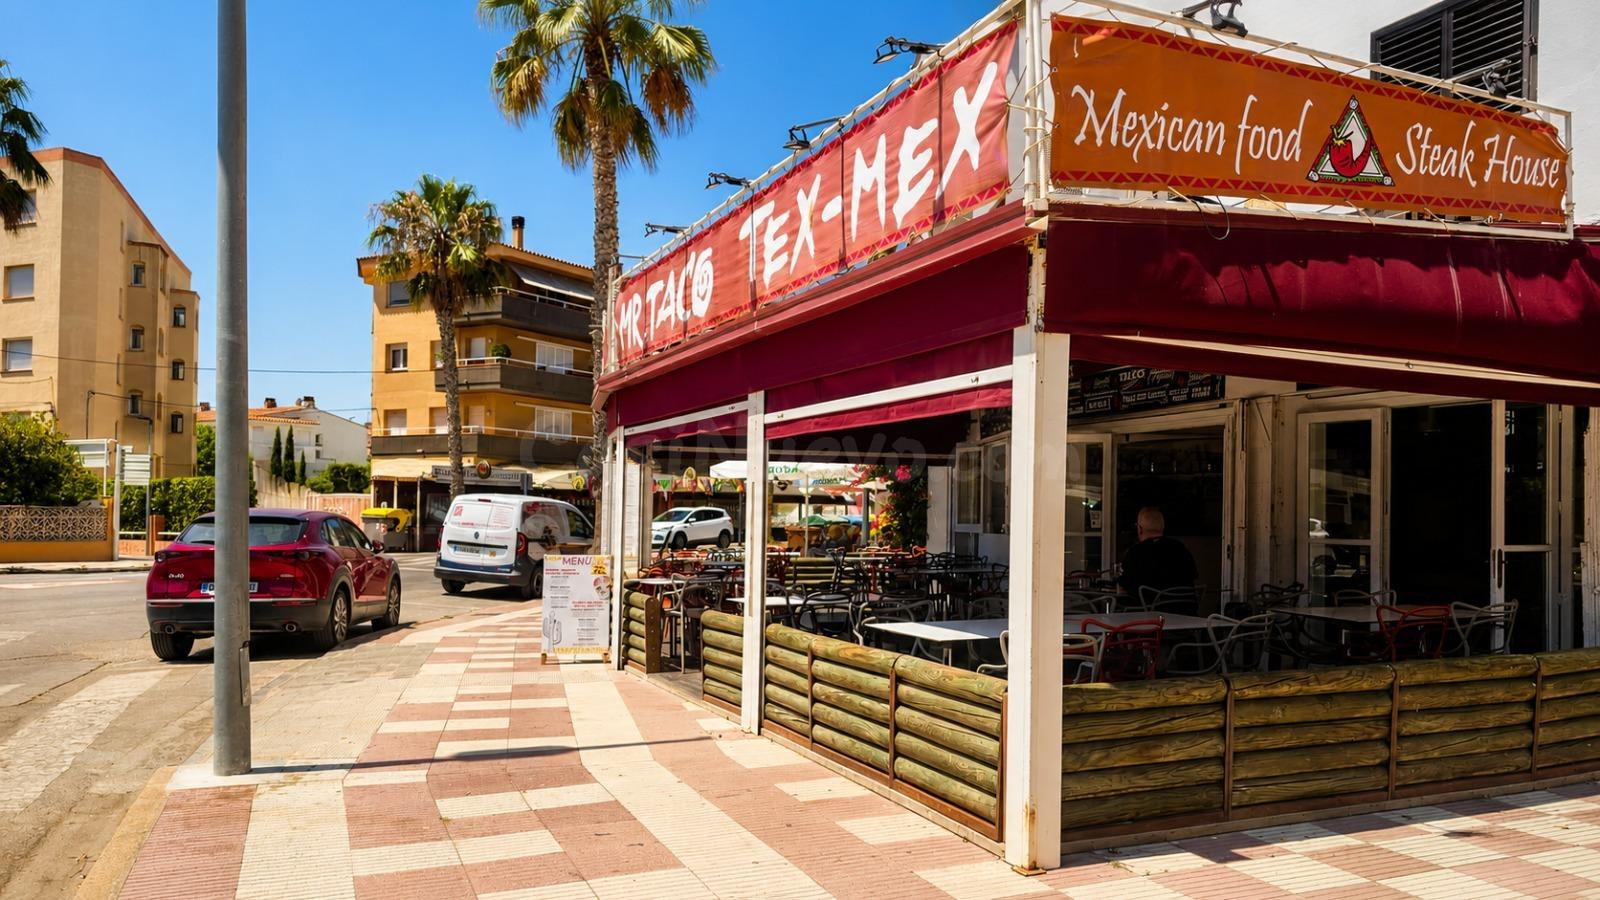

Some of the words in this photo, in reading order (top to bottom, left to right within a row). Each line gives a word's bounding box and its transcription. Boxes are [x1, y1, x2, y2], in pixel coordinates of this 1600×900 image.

[1071, 84, 1227, 165] Mexican
[1233, 94, 1314, 176] food
[1395, 121, 1478, 188] Steak
[1482, 133, 1561, 190] House
[739, 61, 998, 288] TEX-MEX
[562, 556, 593, 566] MENU
